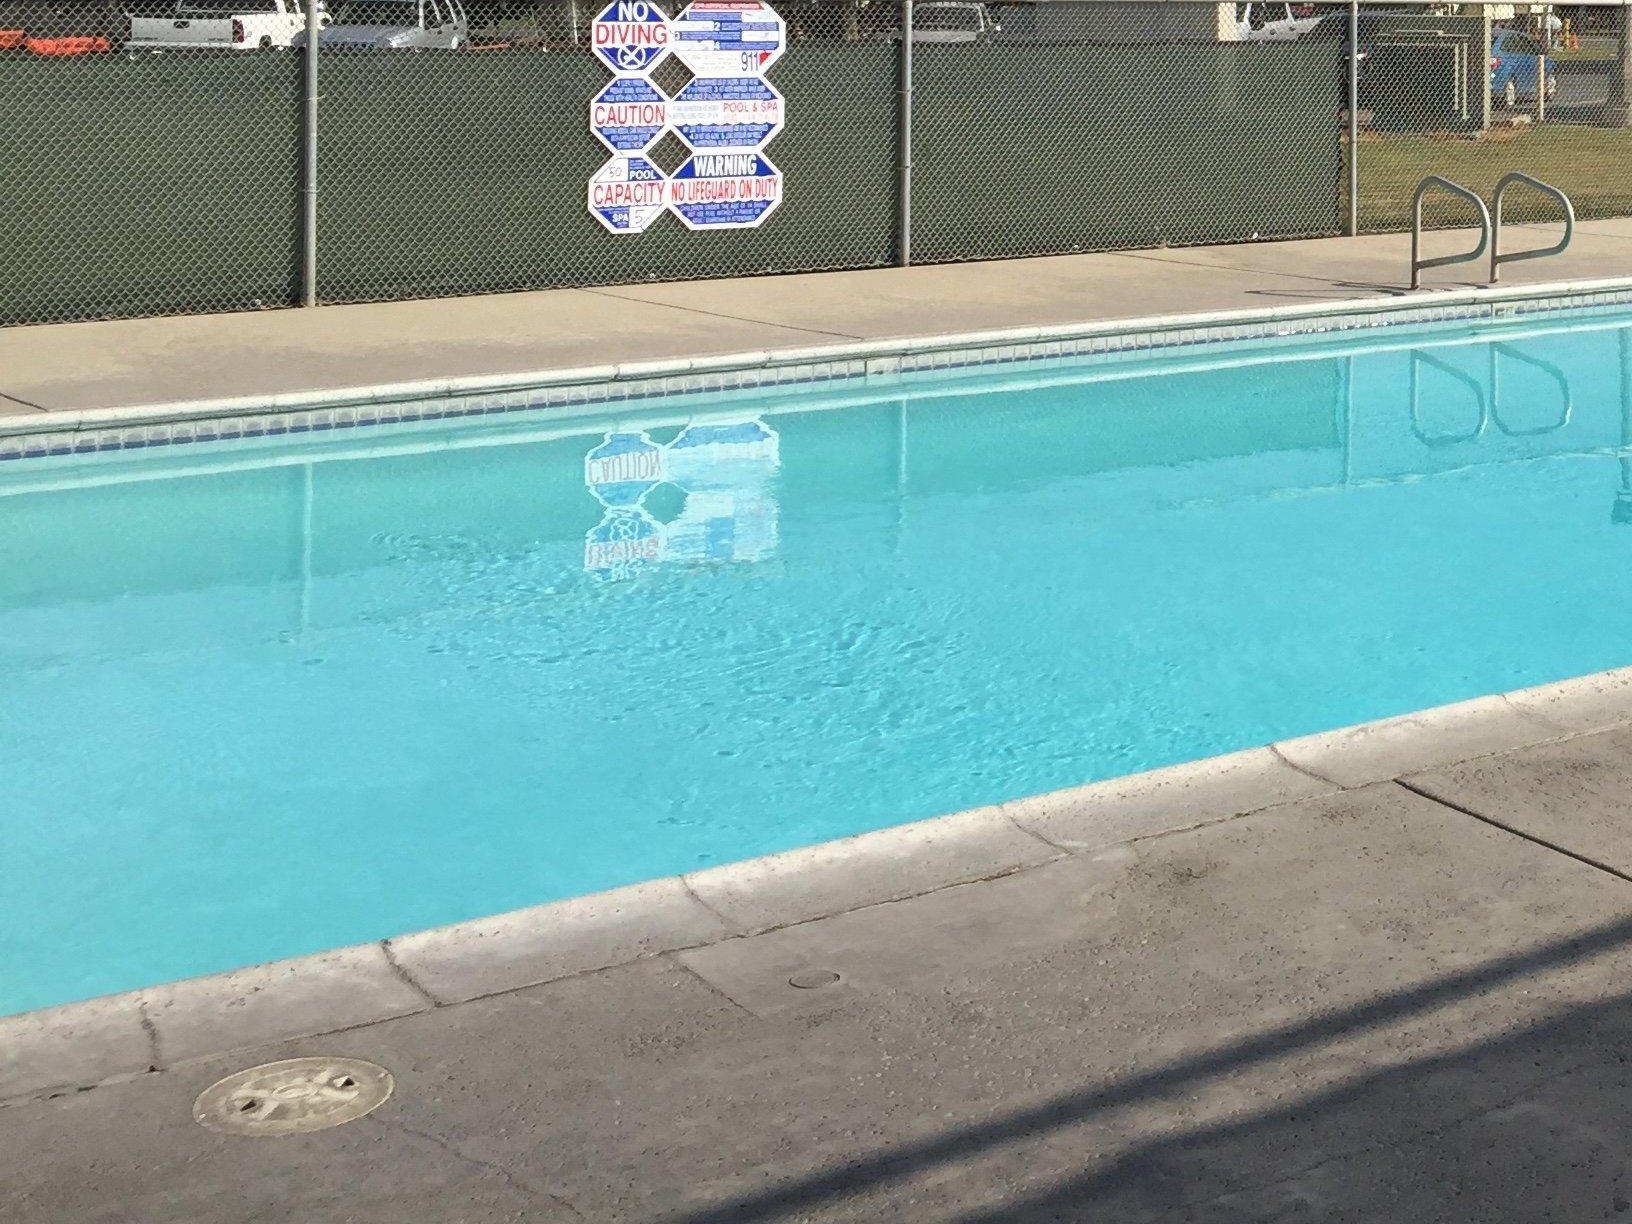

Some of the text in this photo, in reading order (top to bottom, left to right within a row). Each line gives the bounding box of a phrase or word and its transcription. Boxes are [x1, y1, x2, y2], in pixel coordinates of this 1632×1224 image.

[618, 1, 648, 21] NO
[596, 24, 668, 44] DIVING
[741, 51, 759, 71] 911
[594, 104, 666, 126] CAUTION
[723, 103, 749, 113] POOL
[761, 102, 779, 113] SPA
[629, 169, 657, 180] POOL
[694, 155, 757, 176] WARNING
[594, 182, 666, 205] CAPACITY
[672, 177, 779, 201] NO LIFEGUARD ON DUTY
[612, 213, 629, 223] SPA
[634, 209, 645, 224] 5
